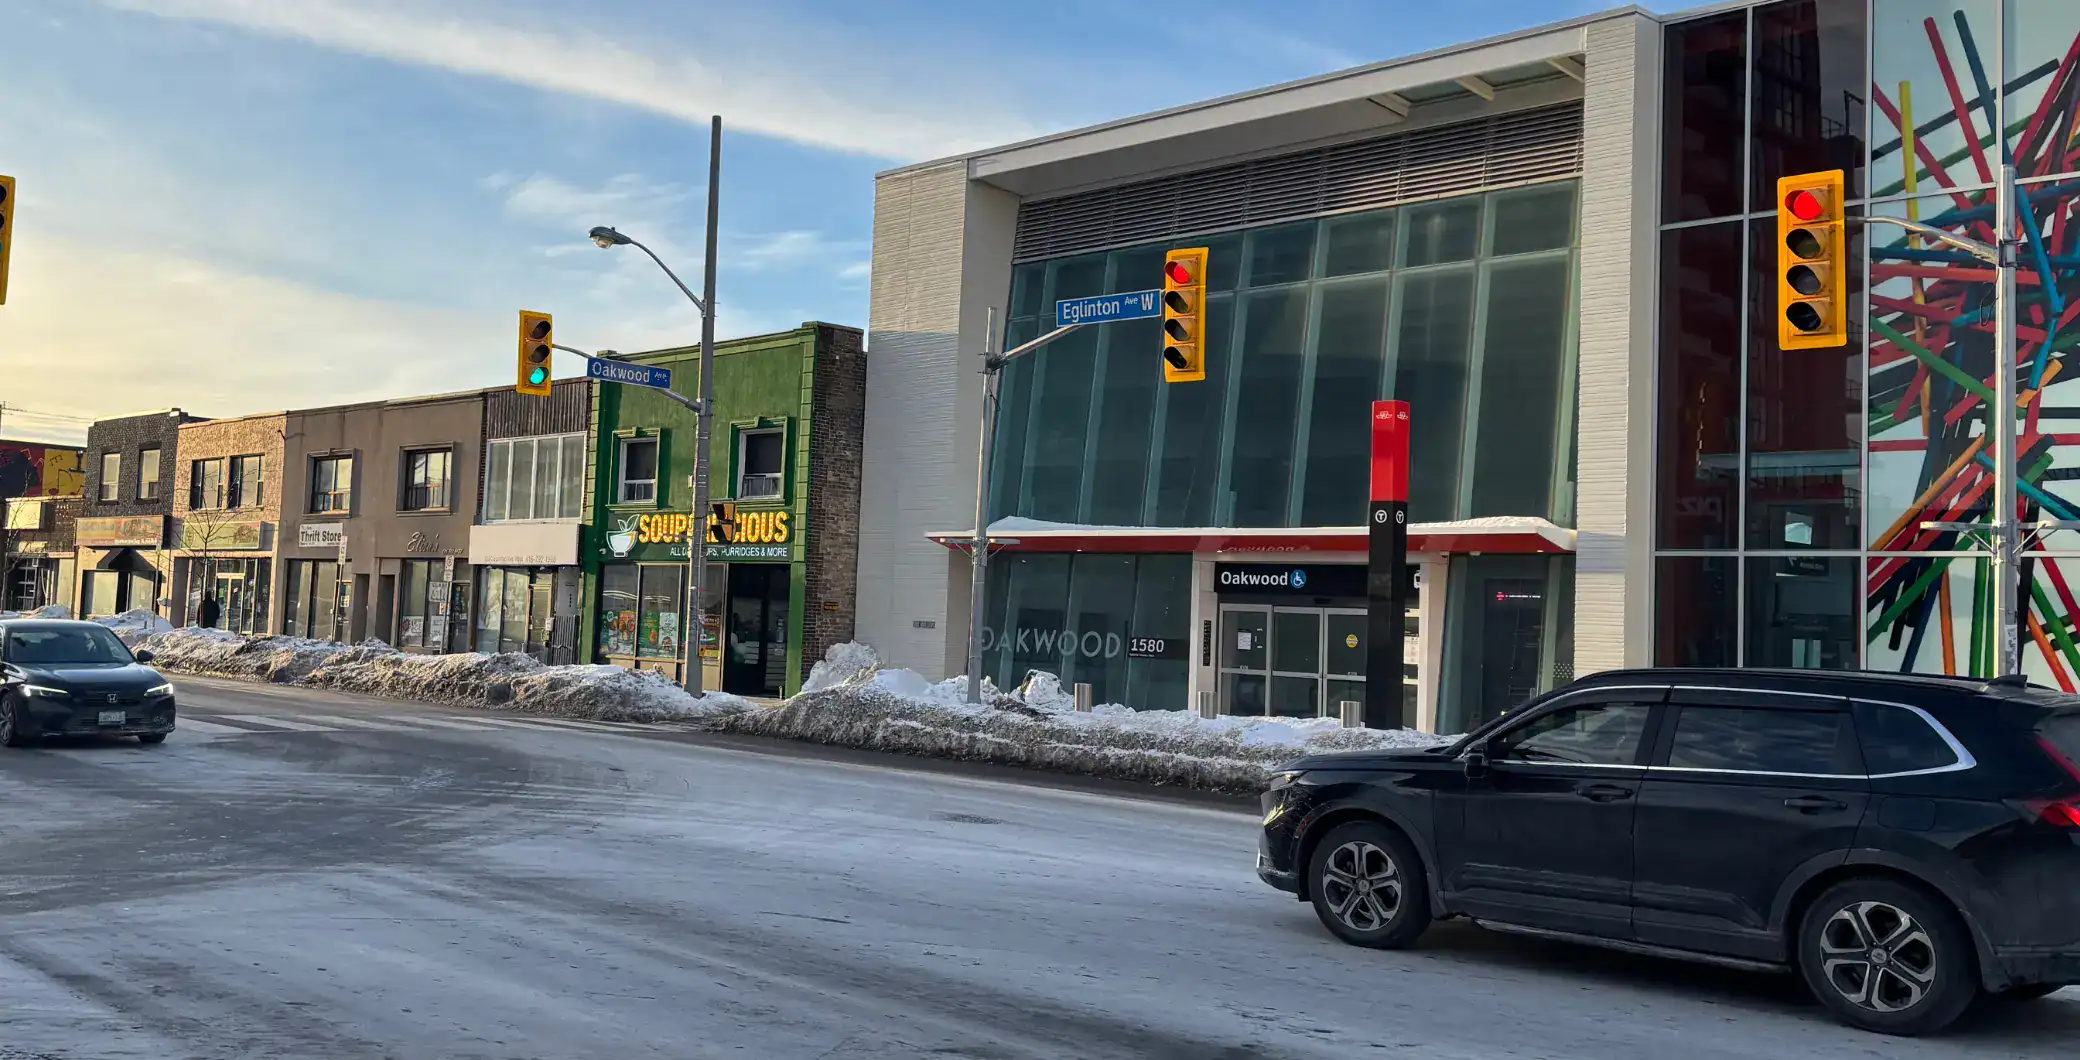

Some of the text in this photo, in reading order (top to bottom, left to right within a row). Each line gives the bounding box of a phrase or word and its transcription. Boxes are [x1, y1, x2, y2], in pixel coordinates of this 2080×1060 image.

[1063, 293, 1154, 322] Eglinton Ave W
[592, 361, 650, 383] Oakwood
[301, 530, 342, 542] Thrift Store
[670, 546, 681, 557] ALL
[760, 547, 766, 557] &
[767, 547, 788, 557] MORE
[1221, 571, 1288, 586] Oakwood
[981, 626, 1121, 659] OAKWOOD
[1131, 638, 1165, 653] 1580
